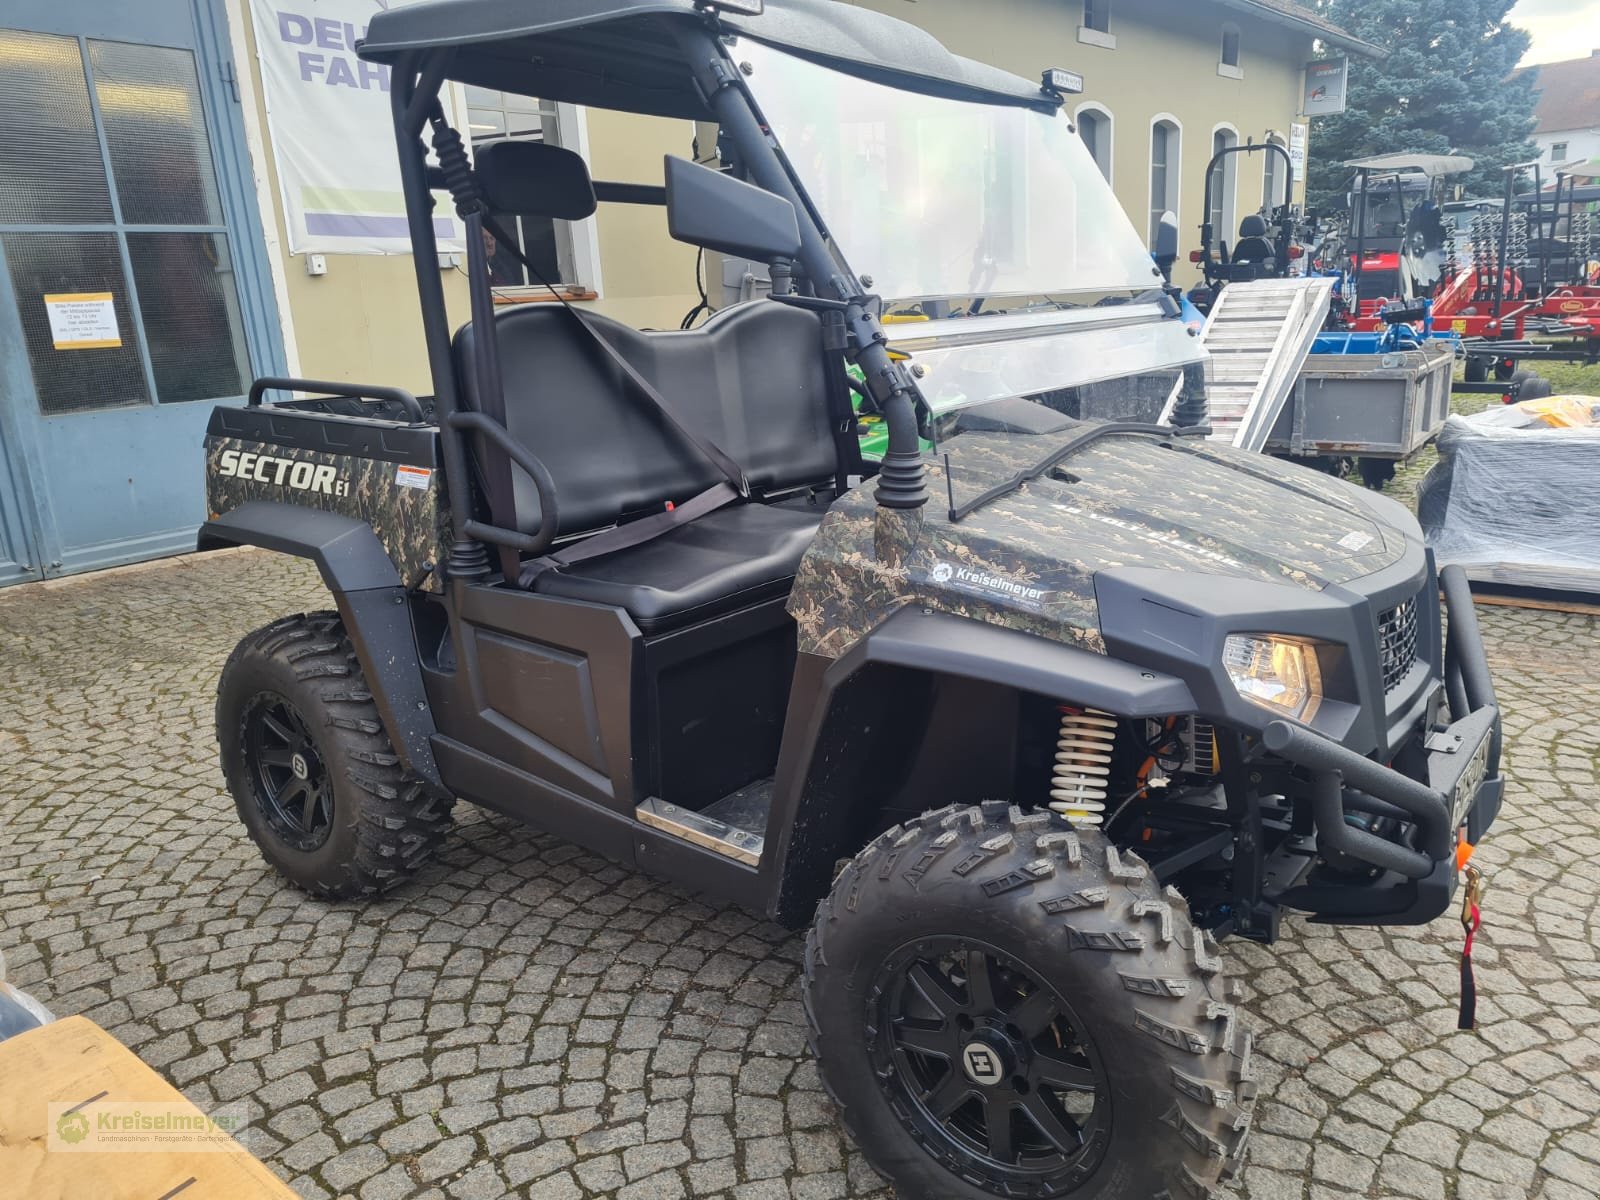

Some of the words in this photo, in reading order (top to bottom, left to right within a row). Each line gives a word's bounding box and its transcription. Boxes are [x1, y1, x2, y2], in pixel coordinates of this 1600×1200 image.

[297, 51, 391, 92] FAH
[219, 449, 337, 495] SECTOR
[956, 567, 1045, 600] Kreiselmeyer
